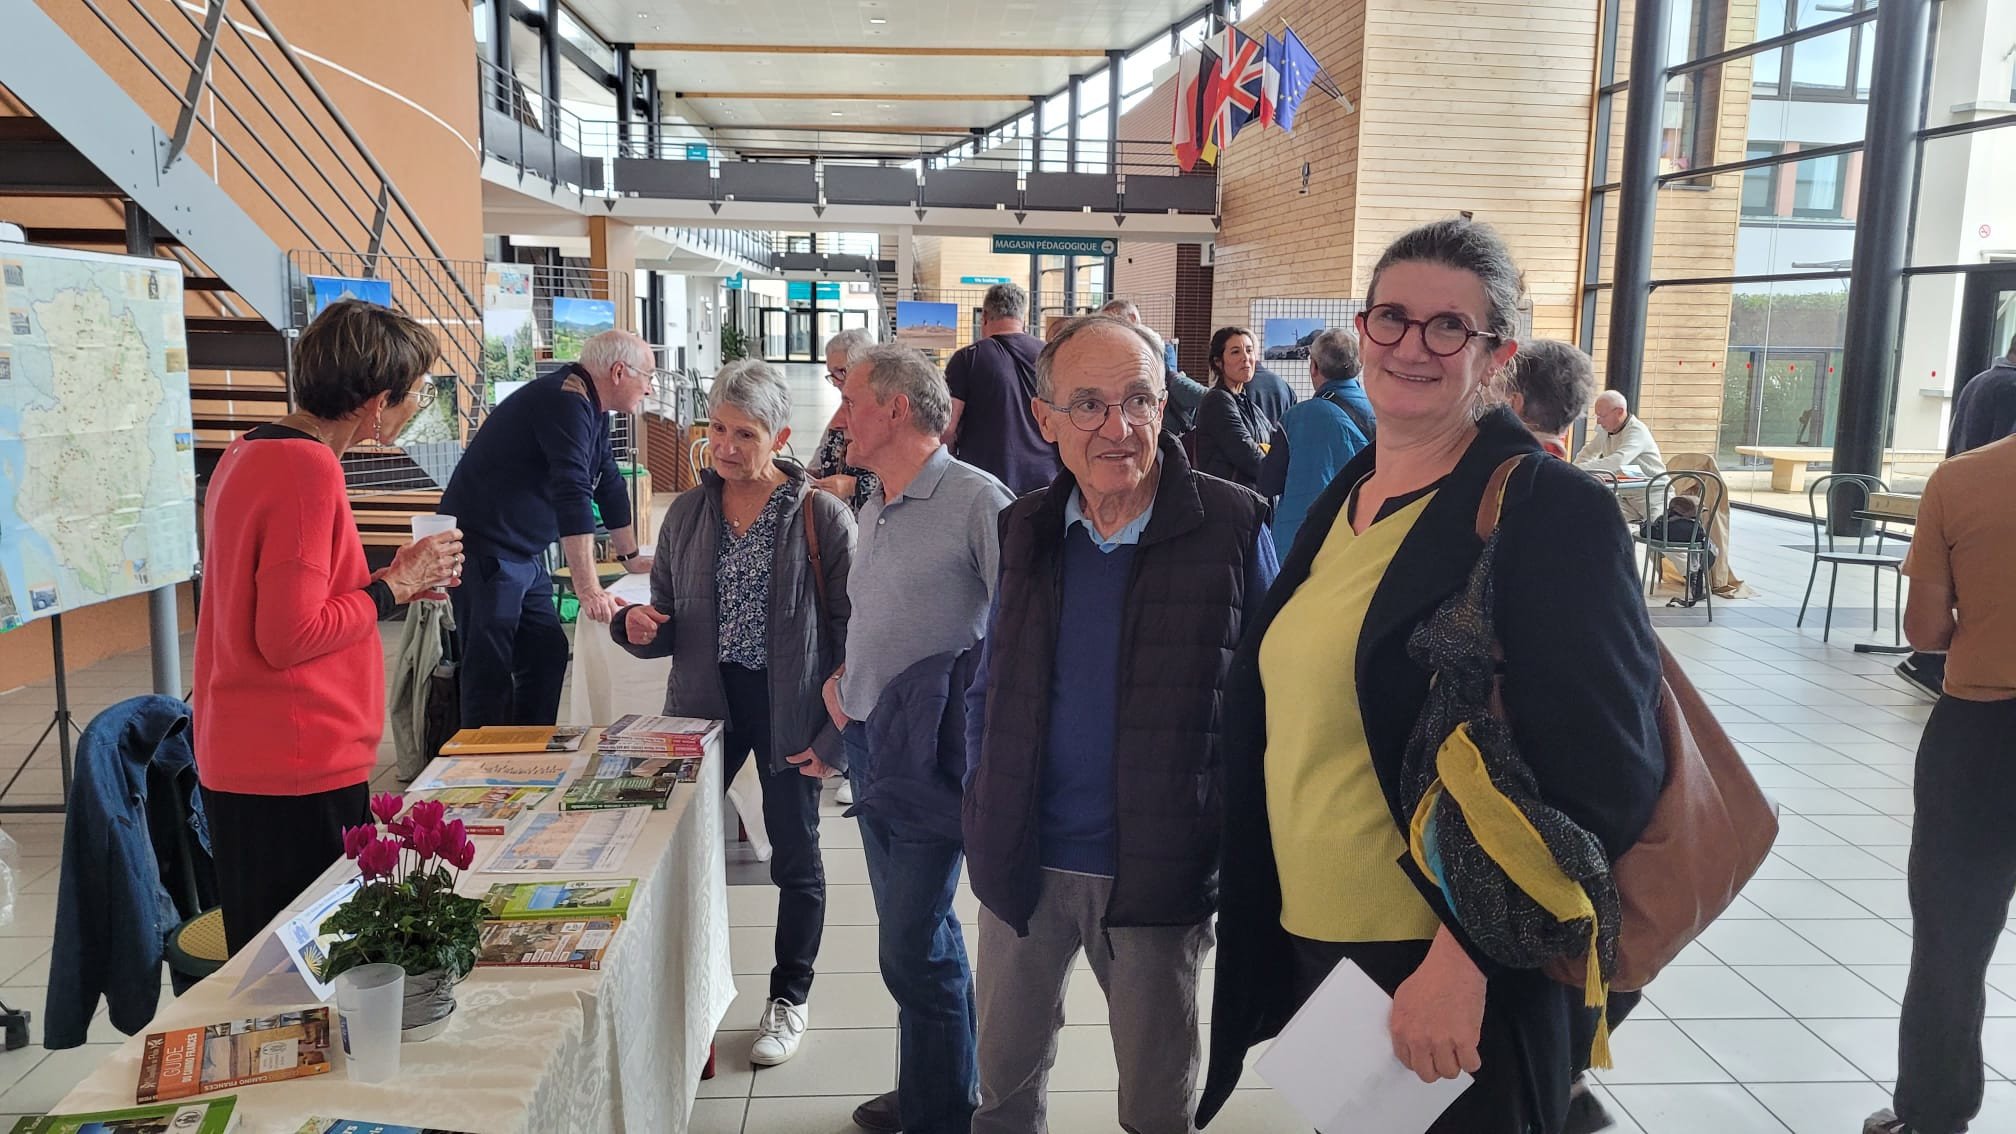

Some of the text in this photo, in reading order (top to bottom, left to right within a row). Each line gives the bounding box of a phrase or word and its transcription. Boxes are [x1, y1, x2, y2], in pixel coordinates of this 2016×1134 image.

[995, 239, 1097, 251] MAGASIN PÉDAGOGIQUE
[163, 1045, 185, 1077] GUIDE
[239, 1075, 268, 1085] CAMINO
